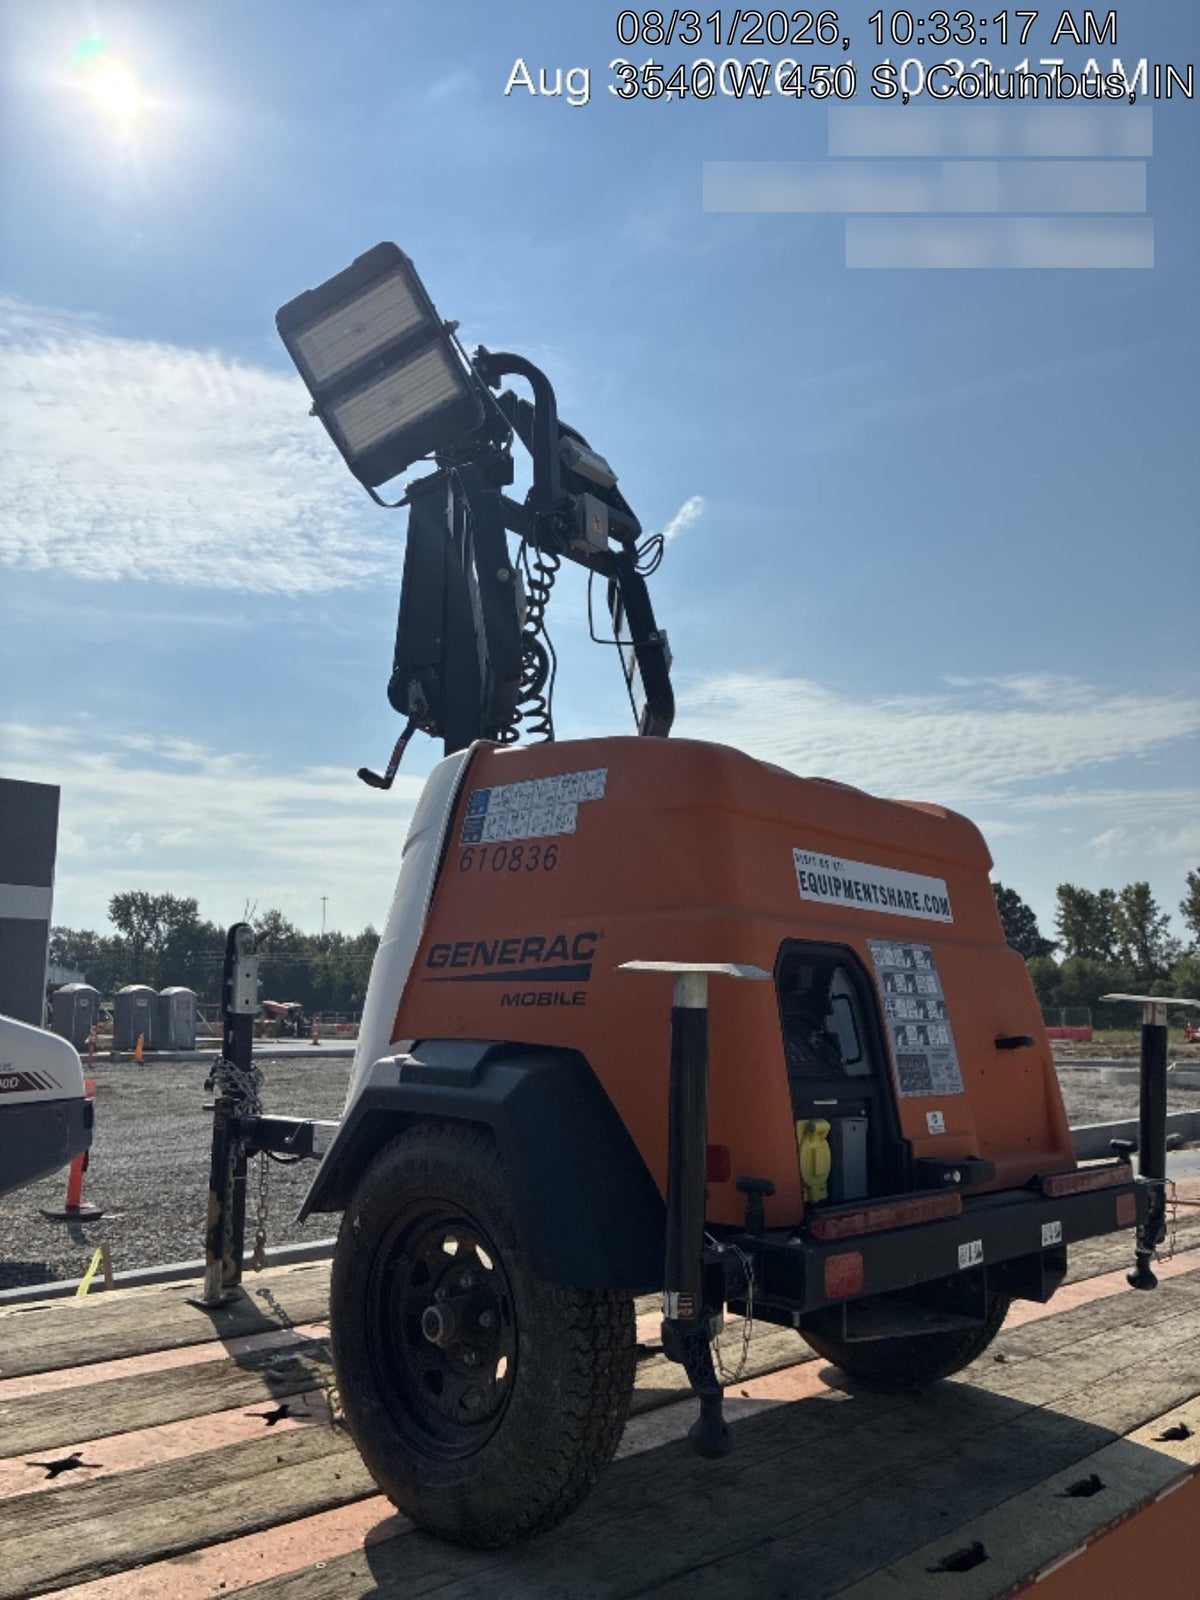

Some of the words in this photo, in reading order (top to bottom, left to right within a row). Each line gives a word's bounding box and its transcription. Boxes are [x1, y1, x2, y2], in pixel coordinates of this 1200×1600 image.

[459, 844, 560, 872] 610836
[799, 870, 951, 917] EQUIPMENTSHARE.COM
[425, 931, 598, 969] GENERAC
[500, 991, 587, 1008] MOBILE
